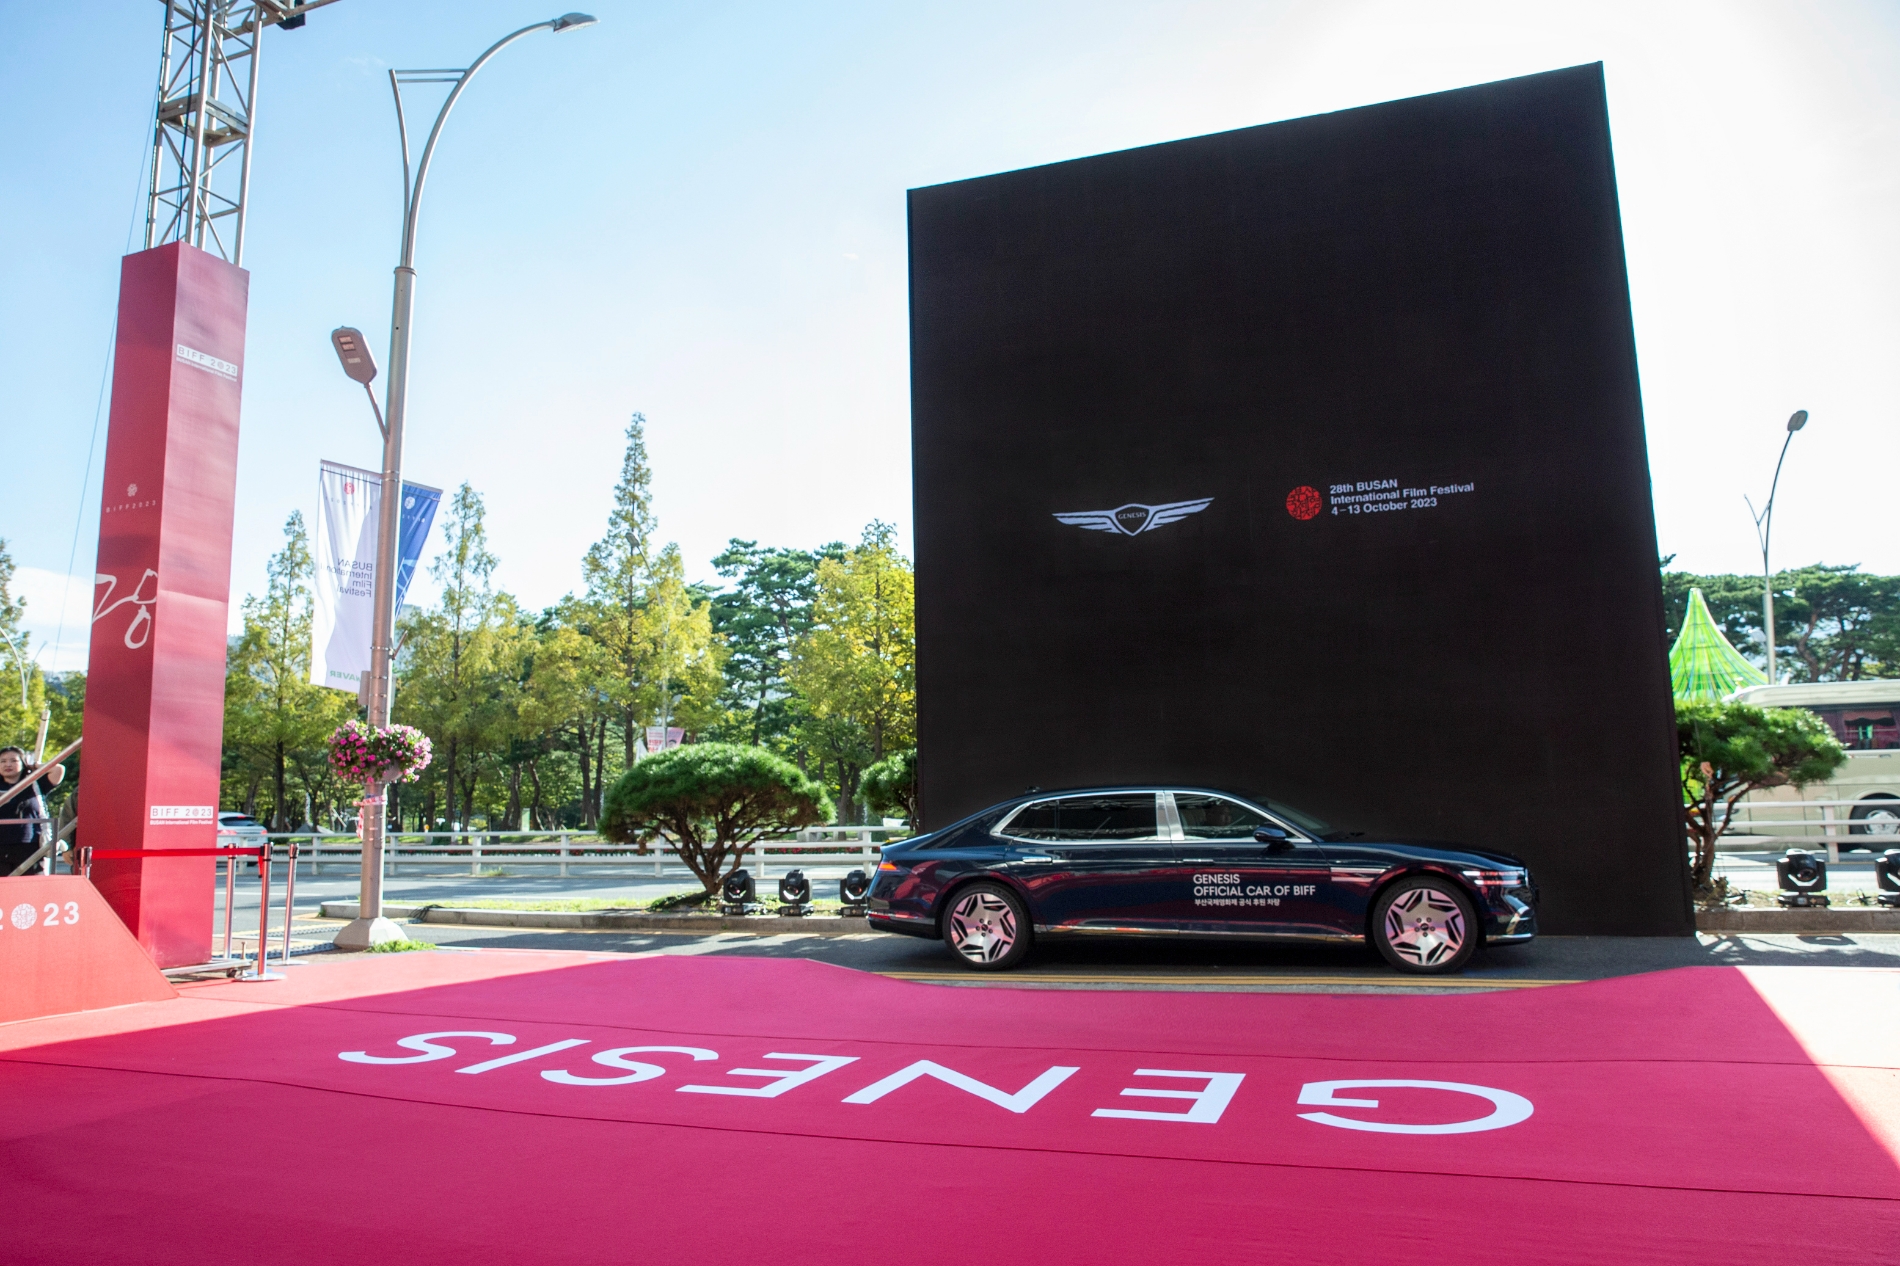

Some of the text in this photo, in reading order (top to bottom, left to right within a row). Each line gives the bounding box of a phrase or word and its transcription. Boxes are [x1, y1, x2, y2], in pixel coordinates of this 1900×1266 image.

[178, 346, 205, 361] BIFF
[1330, 478, 1398, 494] 28th BUSAN
[1330, 482, 1475, 505] International Film Festival
[1363, 501, 1408, 514] October
[1410, 497, 1438, 509] 2023
[1118, 511, 1147, 520] GENESIS
[152, 808, 179, 817] BIFF
[1193, 873, 1241, 885] GENESIS
[1193, 885, 1316, 897] OFFICIAL CAR OF BIFF
[338, 1030, 1535, 1135] GENESIS
